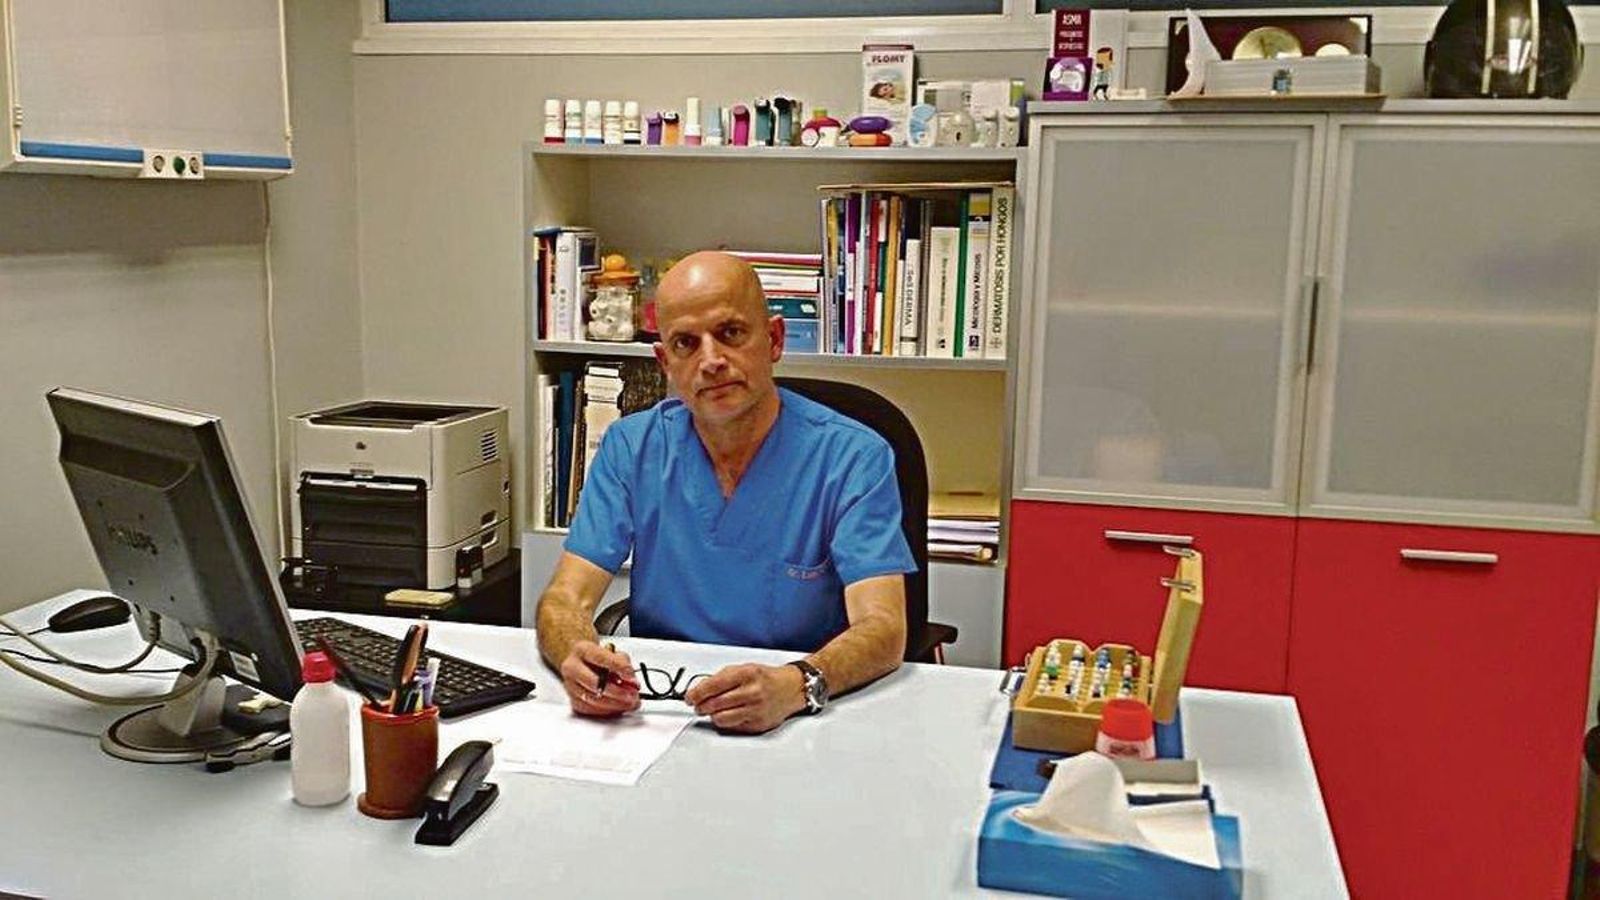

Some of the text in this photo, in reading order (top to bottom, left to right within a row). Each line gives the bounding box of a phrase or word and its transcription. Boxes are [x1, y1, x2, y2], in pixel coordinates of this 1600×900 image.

[1062, 13, 1082, 25] ASMA
[992, 197, 1009, 333] DERMATOSIS POR HONGOS
